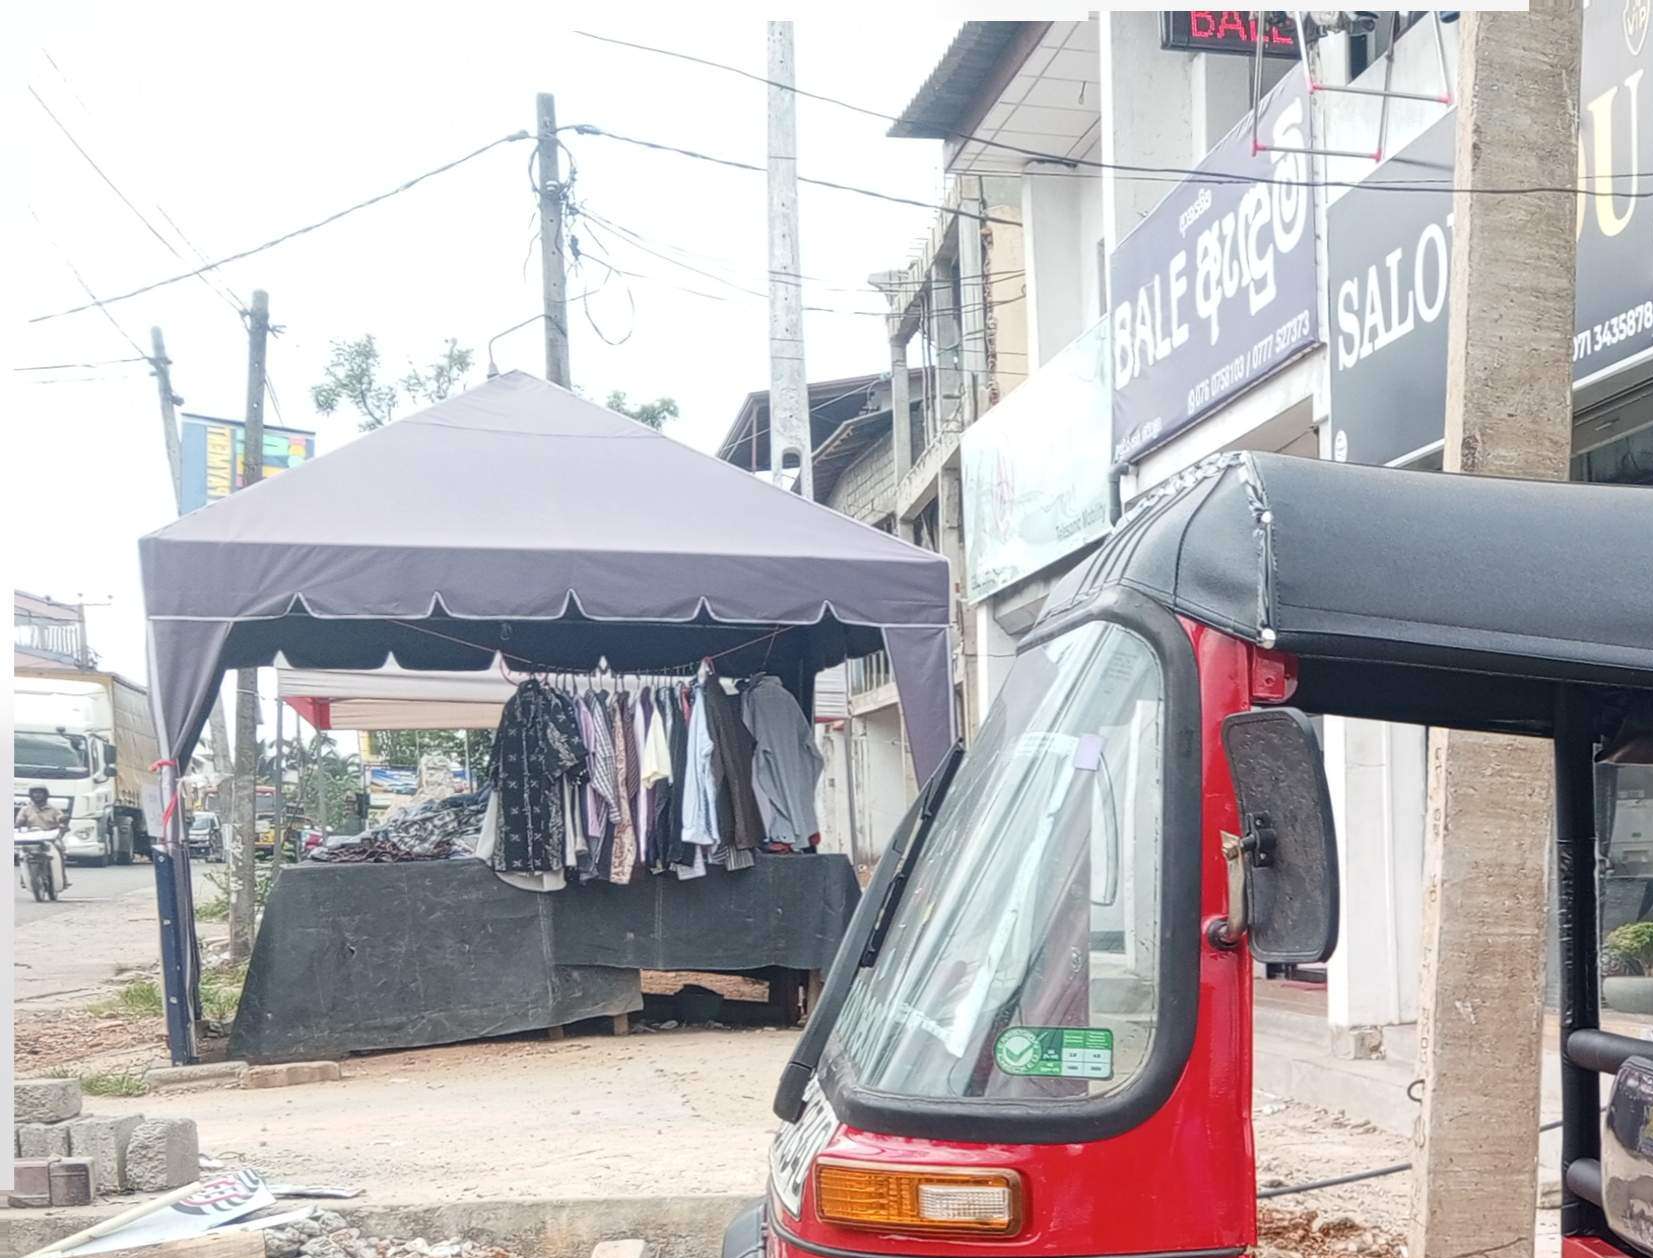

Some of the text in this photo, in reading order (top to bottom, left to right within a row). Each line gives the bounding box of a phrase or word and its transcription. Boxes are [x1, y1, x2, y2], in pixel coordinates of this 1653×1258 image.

[1337, 69, 1643, 371] SALO U
[1114, 250, 1190, 391] BALE
[1594, 301, 1653, 351] 3435878
